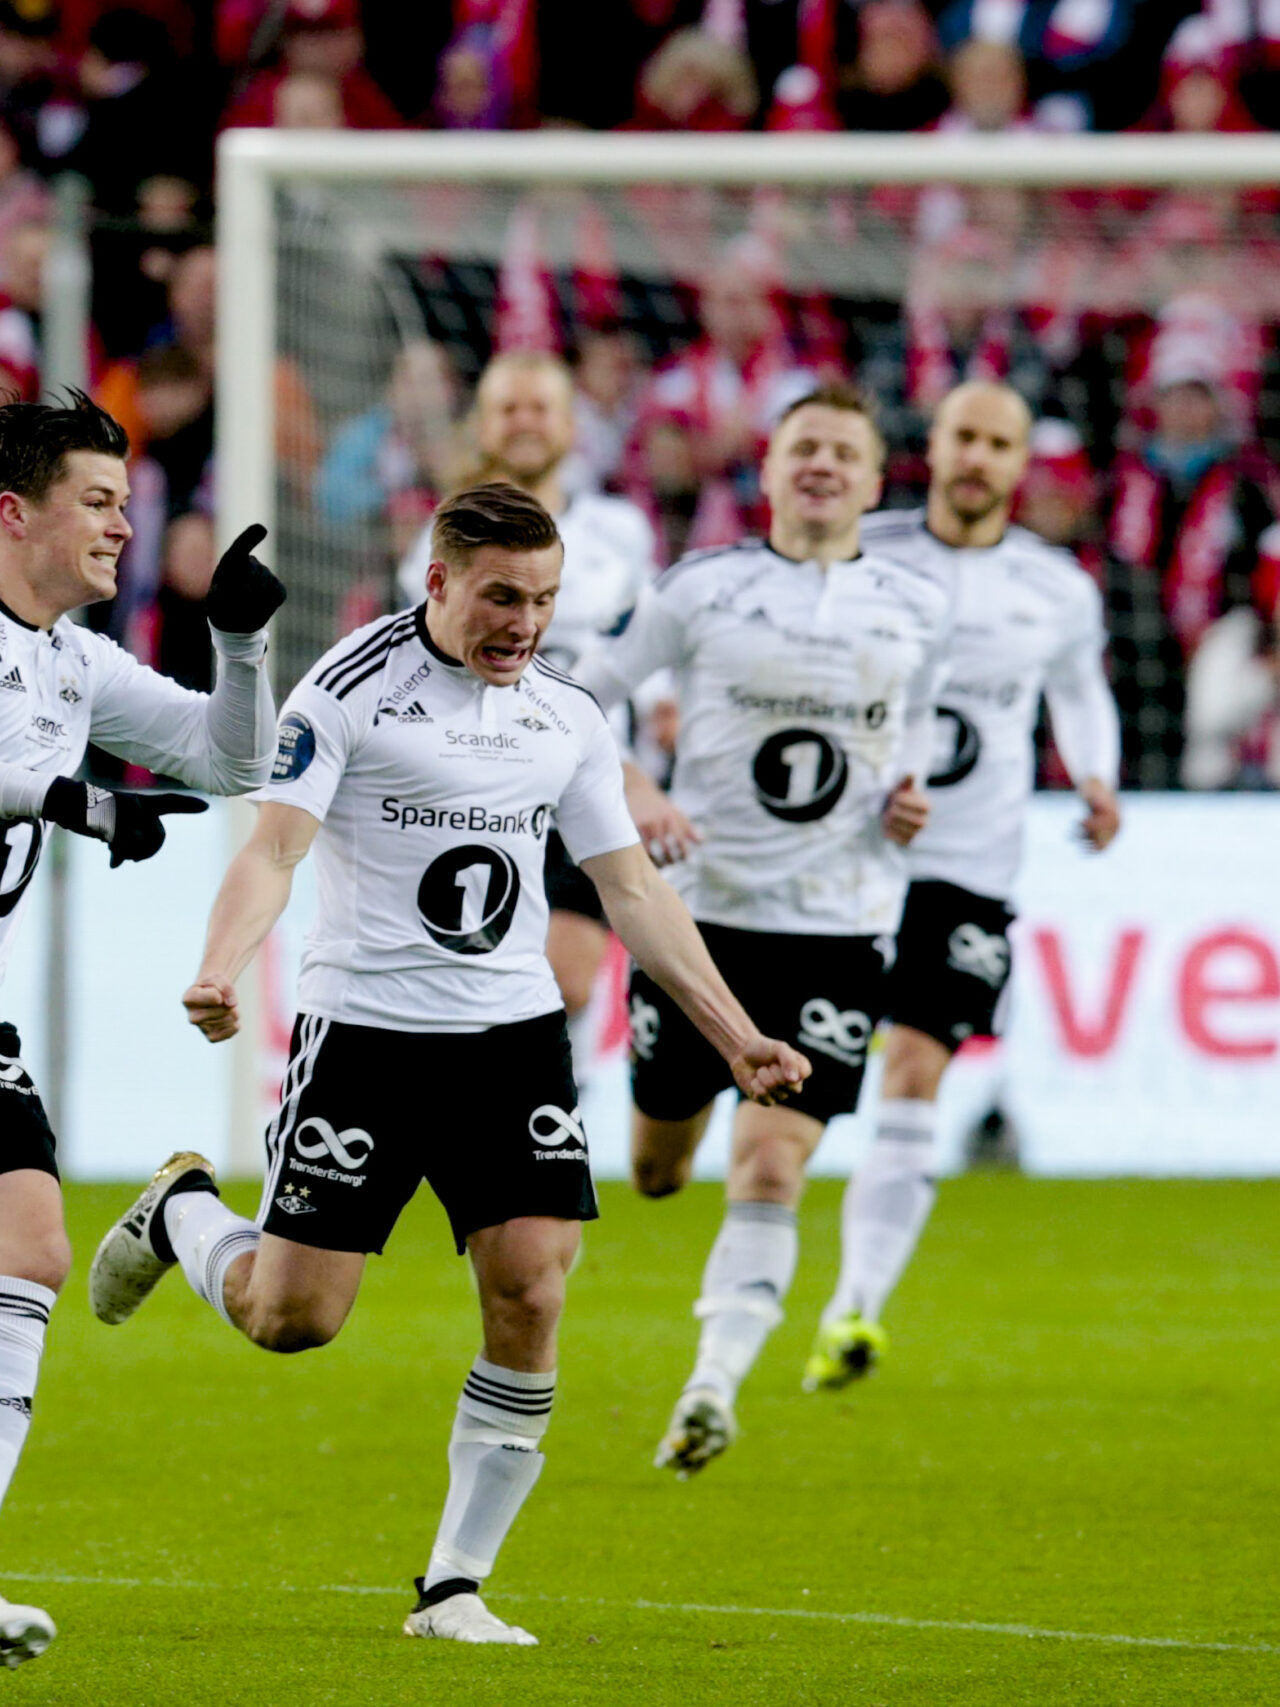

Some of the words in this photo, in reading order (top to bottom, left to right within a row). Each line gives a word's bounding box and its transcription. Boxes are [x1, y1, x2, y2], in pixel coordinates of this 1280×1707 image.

[444, 729, 521, 750] Scandic
[381, 798, 527, 834] SpareBank
[288, 1158, 364, 1188] TrønderEnergi
